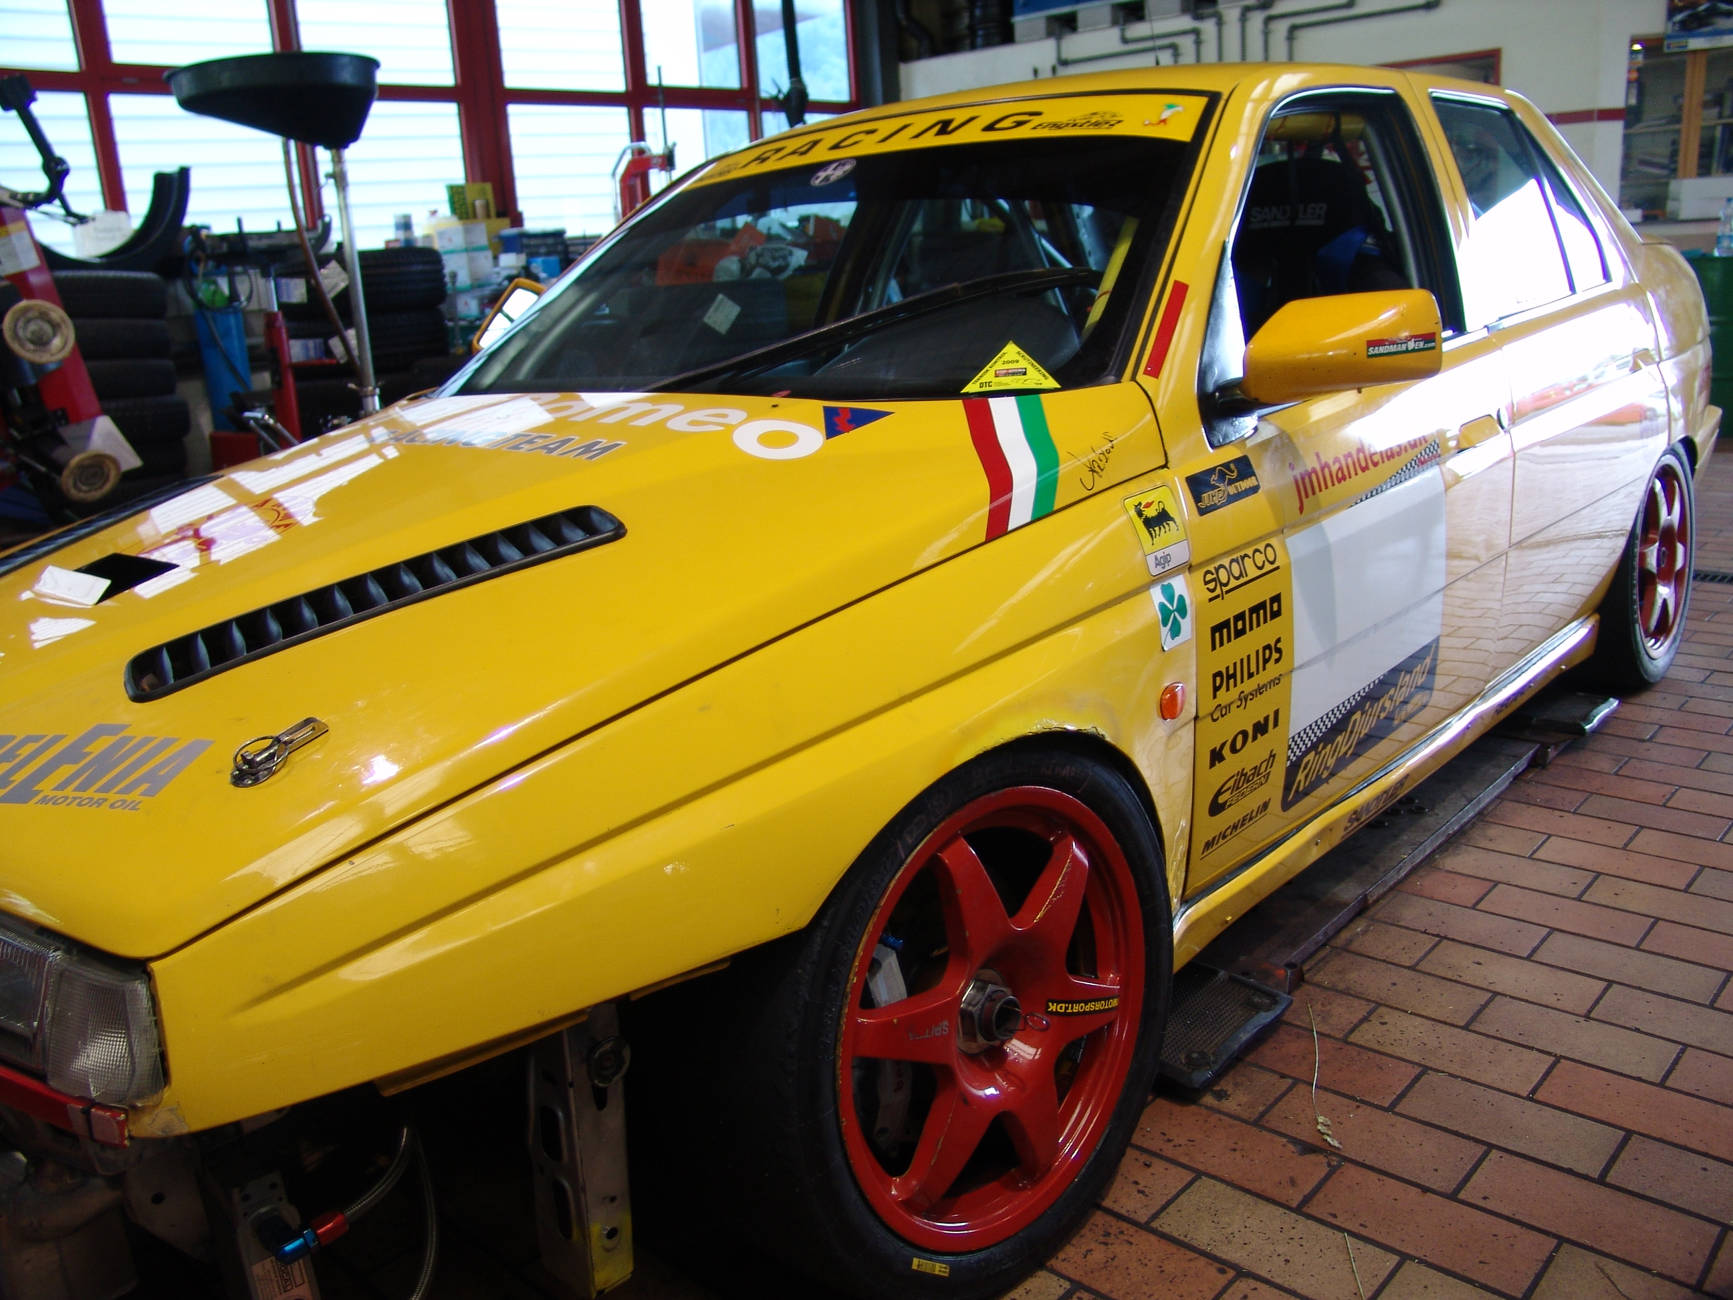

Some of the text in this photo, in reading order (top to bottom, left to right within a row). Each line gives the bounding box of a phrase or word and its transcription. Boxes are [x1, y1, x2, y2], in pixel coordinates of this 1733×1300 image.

[741, 111, 1043, 168] RACING
[1250, 203, 1327, 221] SANDLER
[493, 433, 626, 460] TEAM
[1154, 552, 1172, 570] Agip
[1203, 543, 1277, 600] sparco
[1210, 592, 1282, 652] momo
[1212, 636, 1283, 700] PHILIPS
[1211, 673, 1281, 722] Car Systems
[1209, 708, 1280, 769] KONI
[34, 795, 143, 812] MOTOR OIL
[1208, 749, 1277, 817] Eibach
[1201, 798, 1271, 855] MICHELIN
